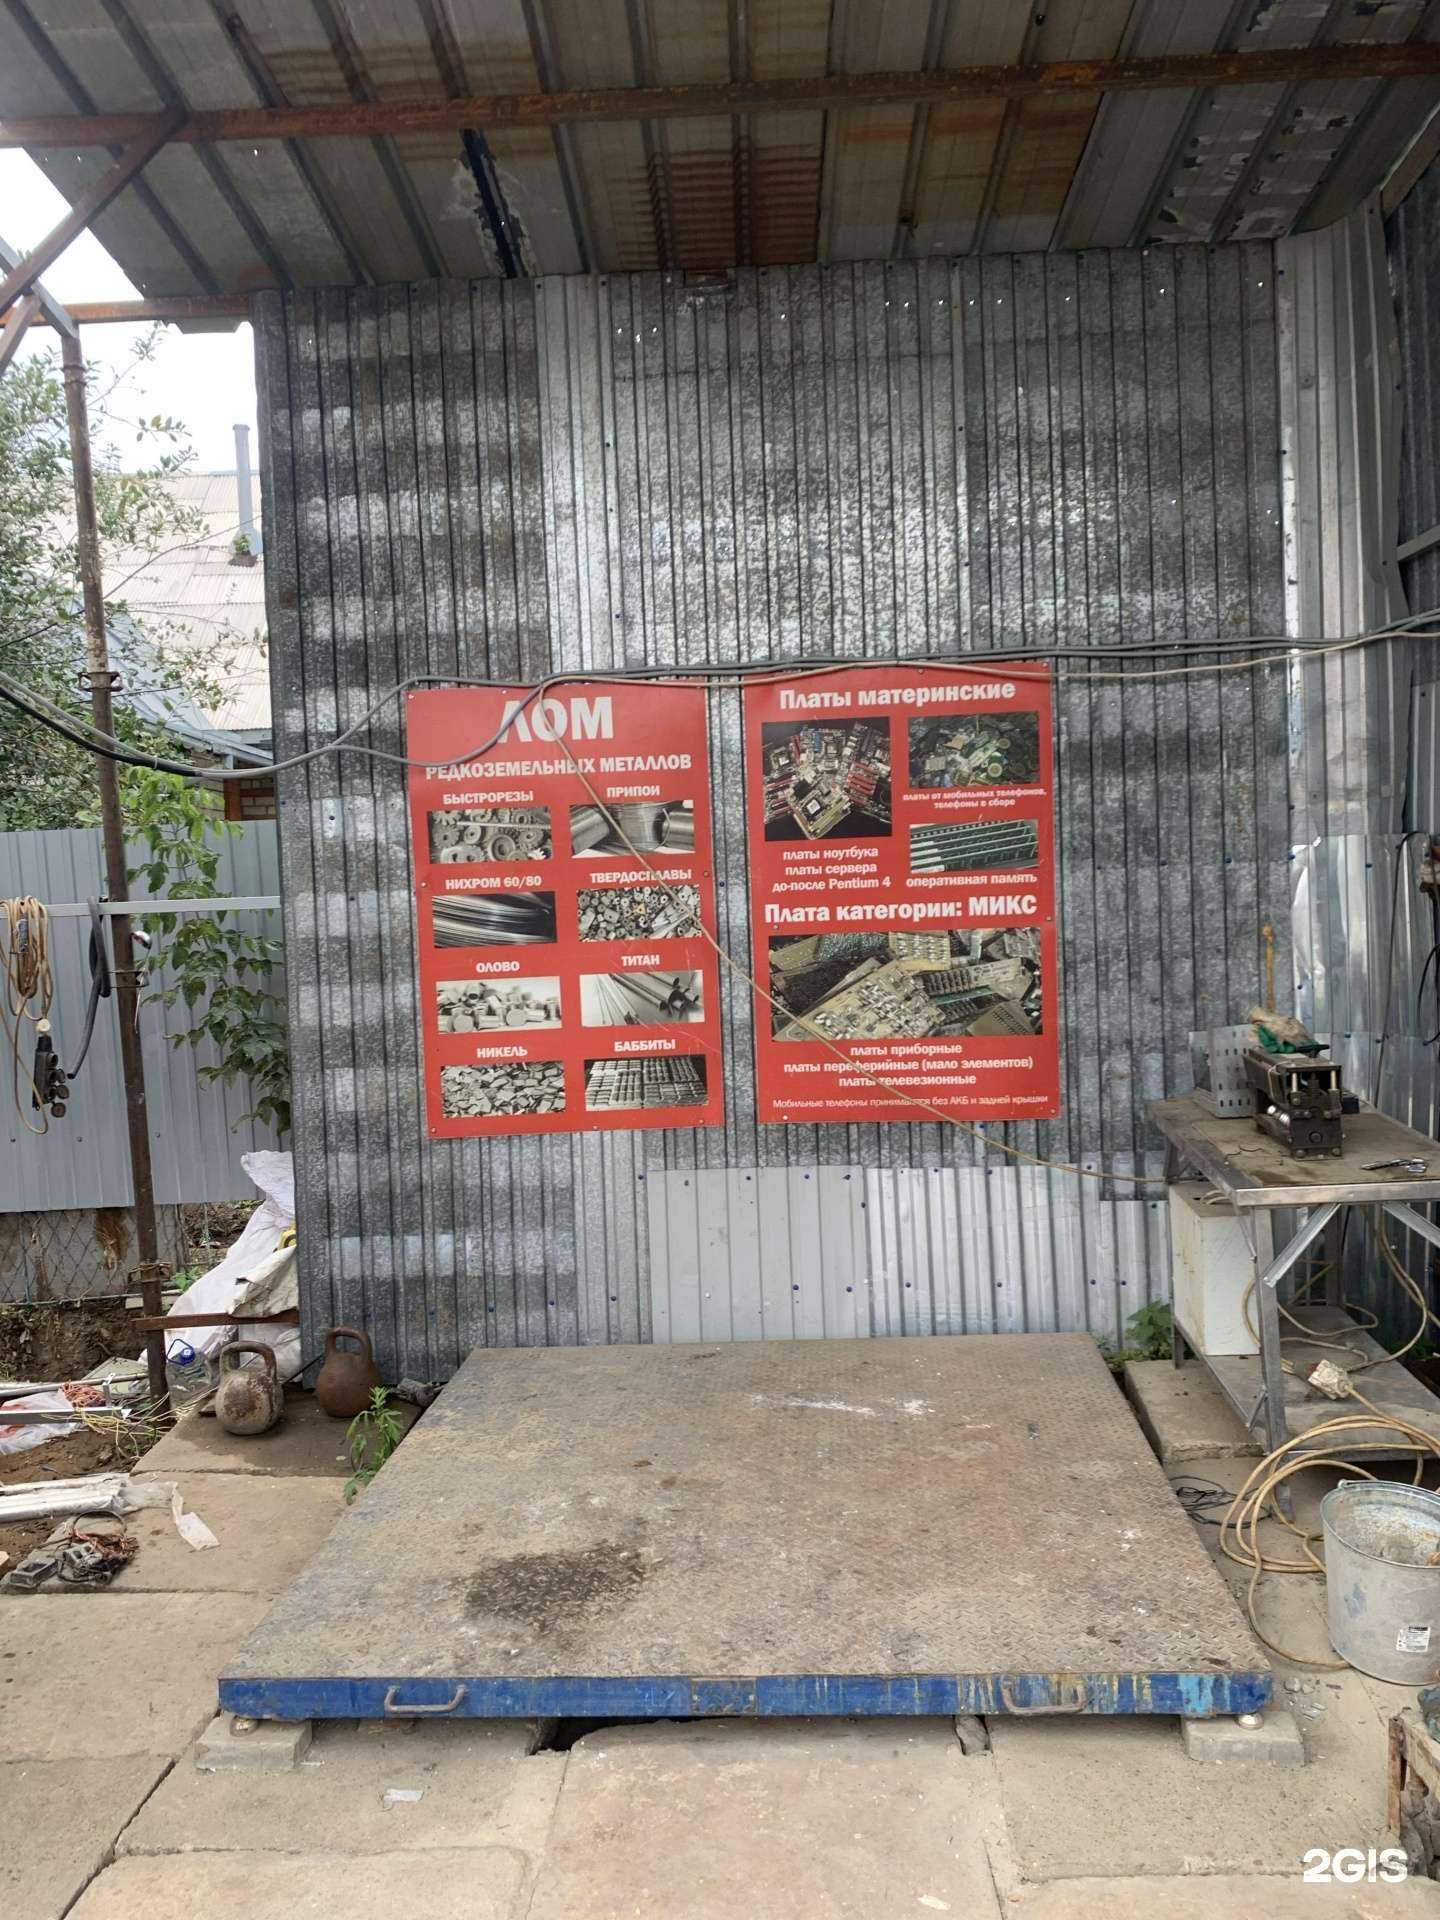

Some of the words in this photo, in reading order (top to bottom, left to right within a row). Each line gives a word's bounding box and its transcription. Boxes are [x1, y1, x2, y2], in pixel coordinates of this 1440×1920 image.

[780, 688, 851, 710] Платы
[858, 682, 1017, 707] материнские
[497, 696, 615, 743] ЛОМ
[426, 757, 595, 781] РЕДКОЗЕМЕЛЬНЫХ
[600, 754, 692, 774] МЕТАЛЛОВ
[443, 790, 534, 805] БЫСТРОРЕЗЫ
[902, 793, 930, 801] платы
[943, 790, 995, 800] мобильных
[934, 800, 979, 809] телефоны
[988, 798, 1016, 808] сборе
[783, 849, 820, 861] платы
[823, 846, 879, 860] ноутбука
[785, 864, 822, 876] платы
[825, 862, 877, 876] сервера
[445, 877, 501, 890] НИХРОМ
[504, 875, 542, 889] 60/80
[772, 879, 826, 894] до-после
[829, 877, 879, 889] Pentium
[882, 877, 891, 888] 4
[906, 874, 988, 888] оперативная
[990, 873, 1038, 885] память
[764, 903, 830, 924] Плата
[836, 899, 963, 922] категории:
[968, 894, 1037, 916] МИКС
[475, 960, 520, 973] ОЛОВО
[621, 954, 661, 967] ТИТАН
[476, 1046, 528, 1059] НИКЕЛЬ
[614, 1039, 676, 1053] БАББИТЫ
[850, 1045, 888, 1056] платы
[890, 1043, 963, 1056] приборные
[784, 1062, 821, 1073] платы
[922, 1058, 958, 1071] (мало
[961, 1056, 1034, 1070] элементов)
[838, 1076, 876, 1088] платы
[773, 1099, 824, 1108] Мобильные
[825, 1099, 868, 1108] телефоны
[932, 1095, 948, 1105] без
[949, 1095, 969, 1105] АКБ
[970, 1097, 977, 1105] и
[978, 1094, 1010, 1106] задней
[1012, 1094, 1048, 1106] крышки
